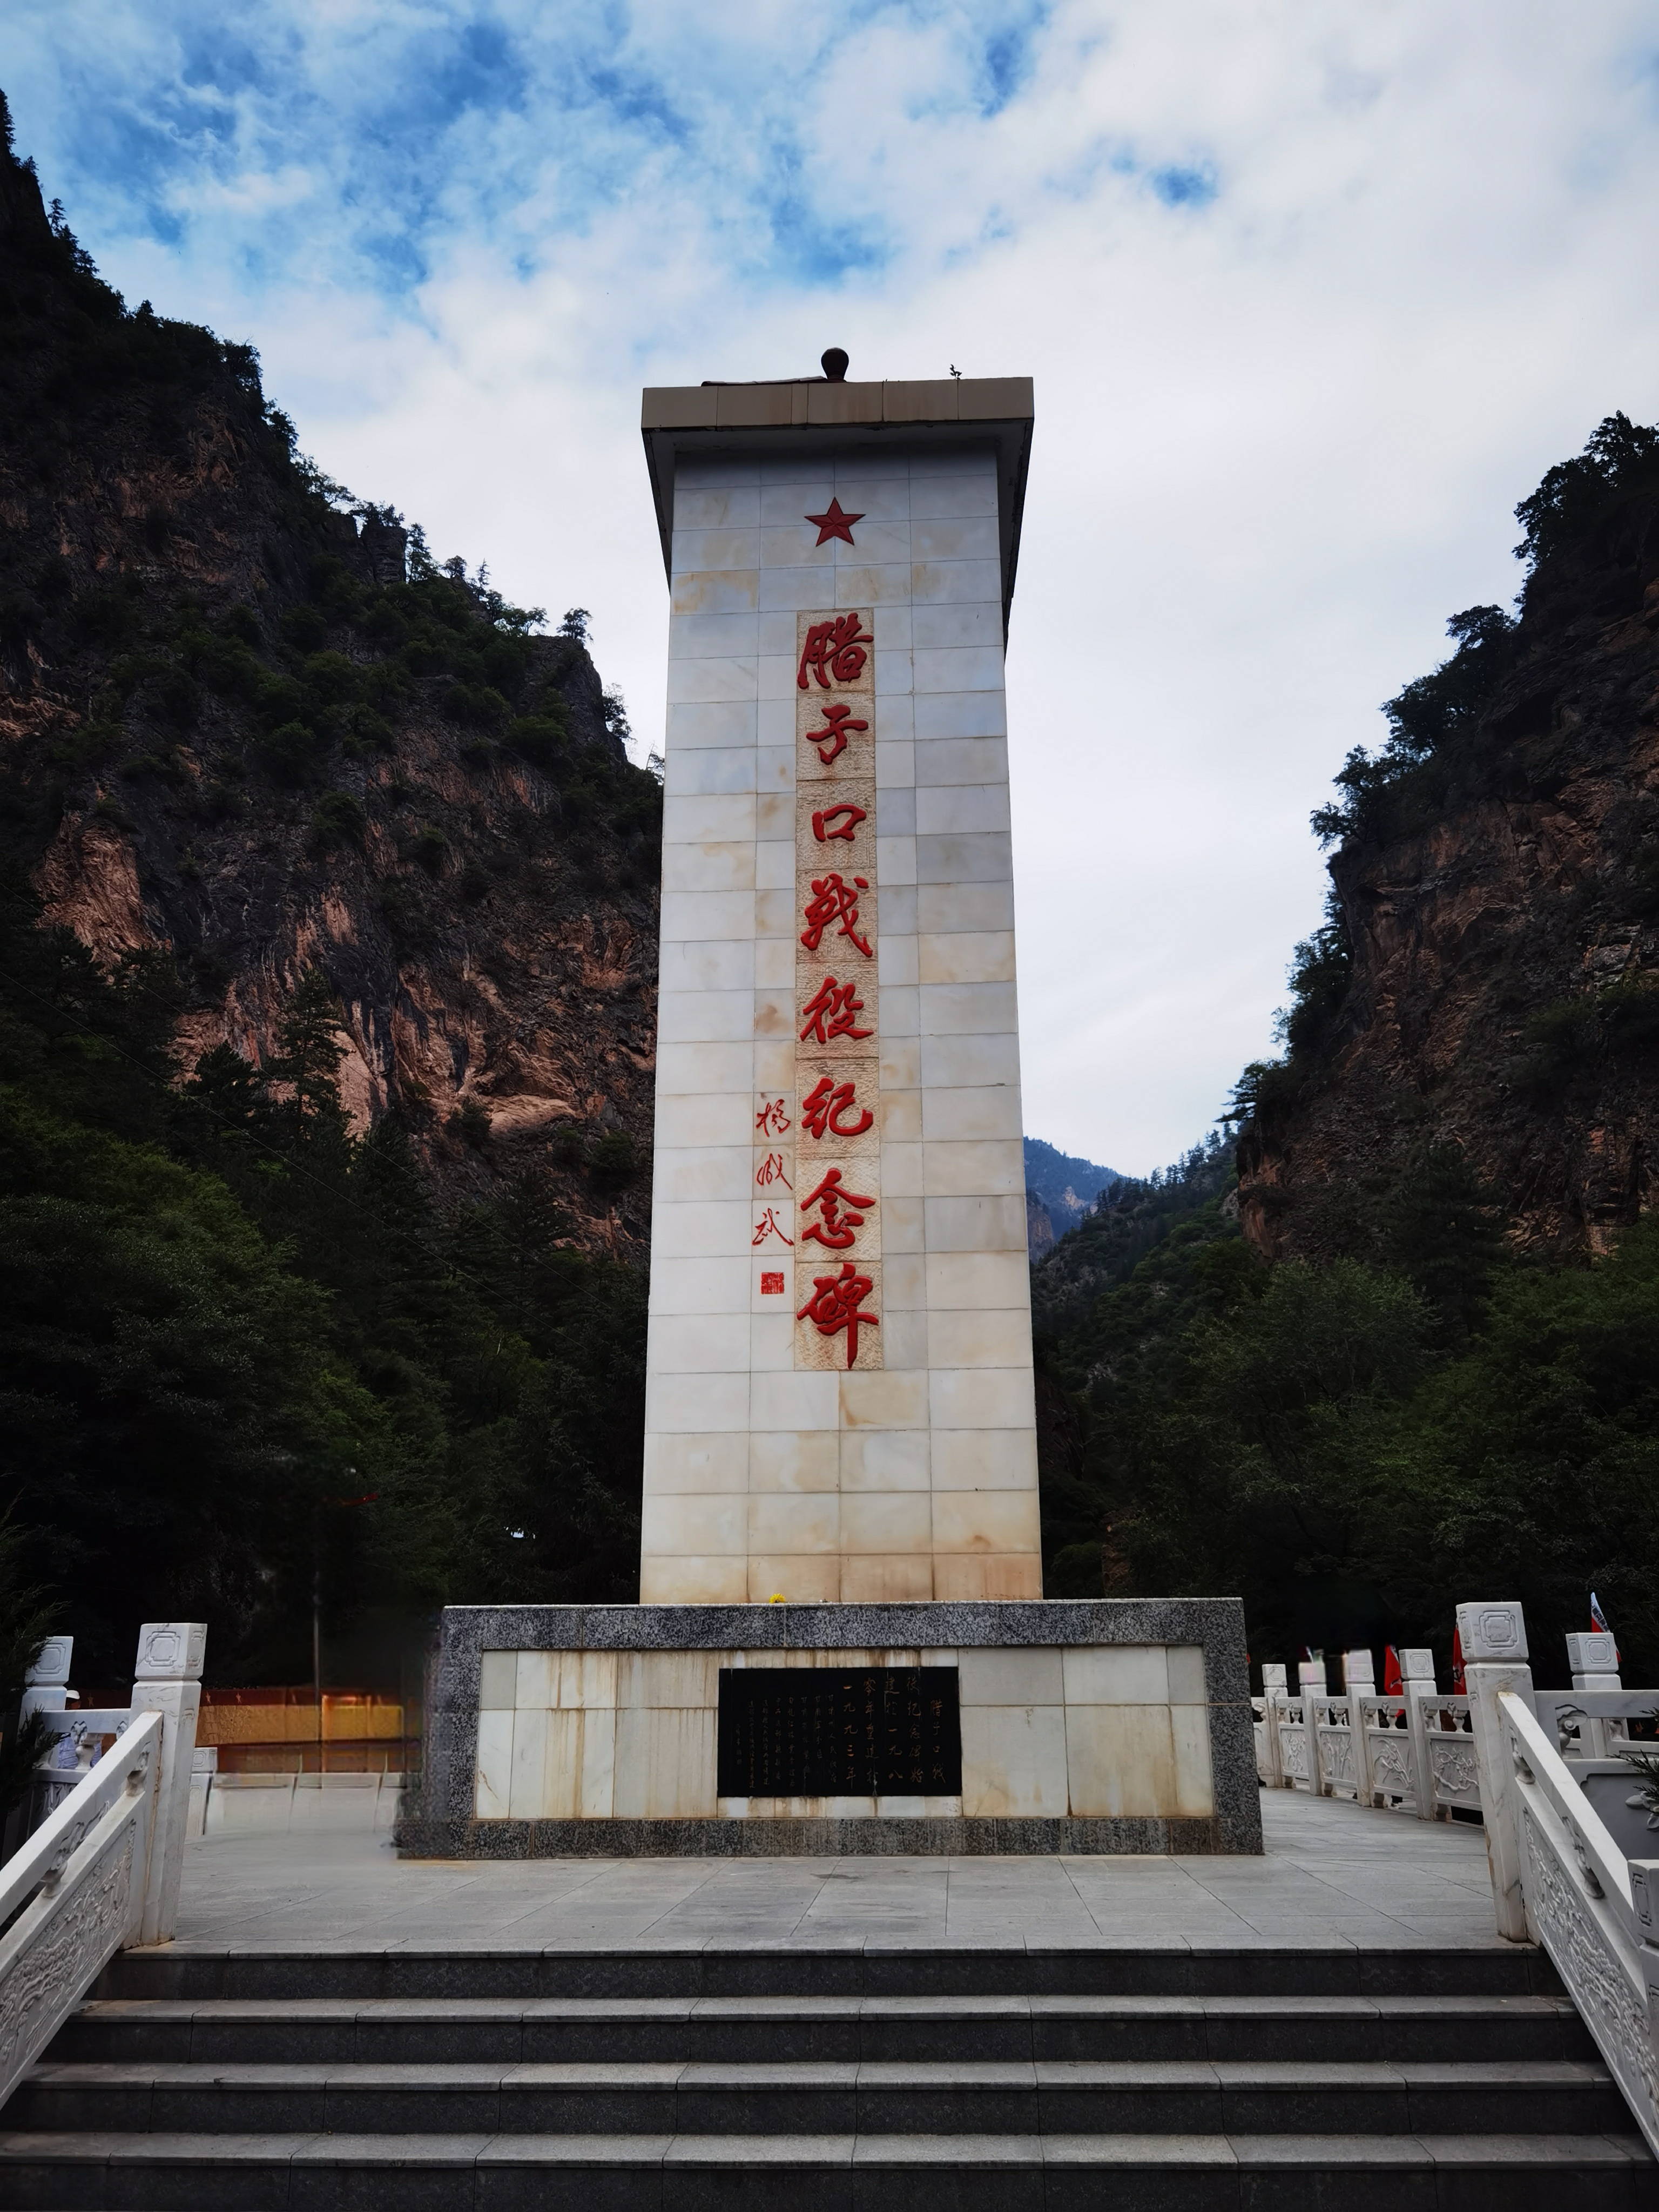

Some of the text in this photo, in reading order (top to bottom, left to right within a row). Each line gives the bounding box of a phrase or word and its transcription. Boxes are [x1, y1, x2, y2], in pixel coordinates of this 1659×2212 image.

[842, 1684, 859, 1790] 一九九三年
